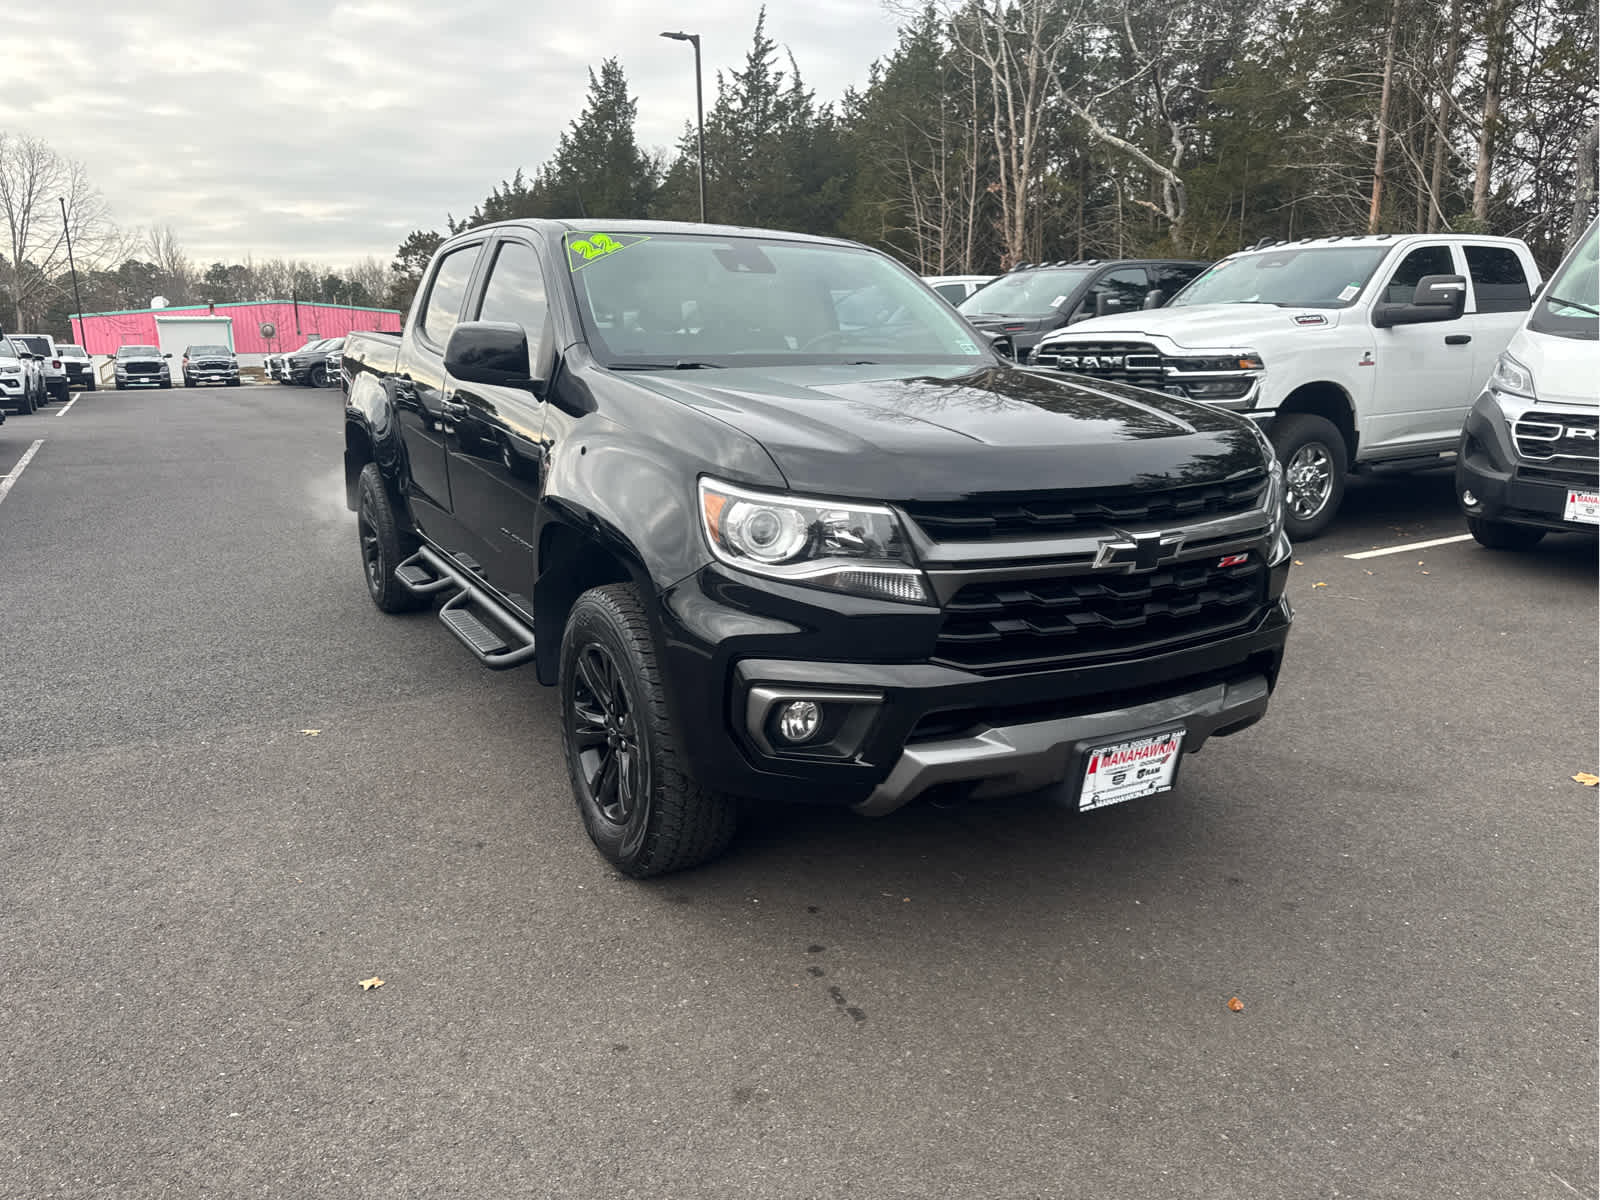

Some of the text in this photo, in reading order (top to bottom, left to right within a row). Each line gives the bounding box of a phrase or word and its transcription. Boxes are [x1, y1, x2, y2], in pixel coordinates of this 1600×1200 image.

[570, 233, 625, 260] 22
[1060, 356, 1123, 368] RAM
[1101, 740, 1178, 768] MANAHAWKIN
